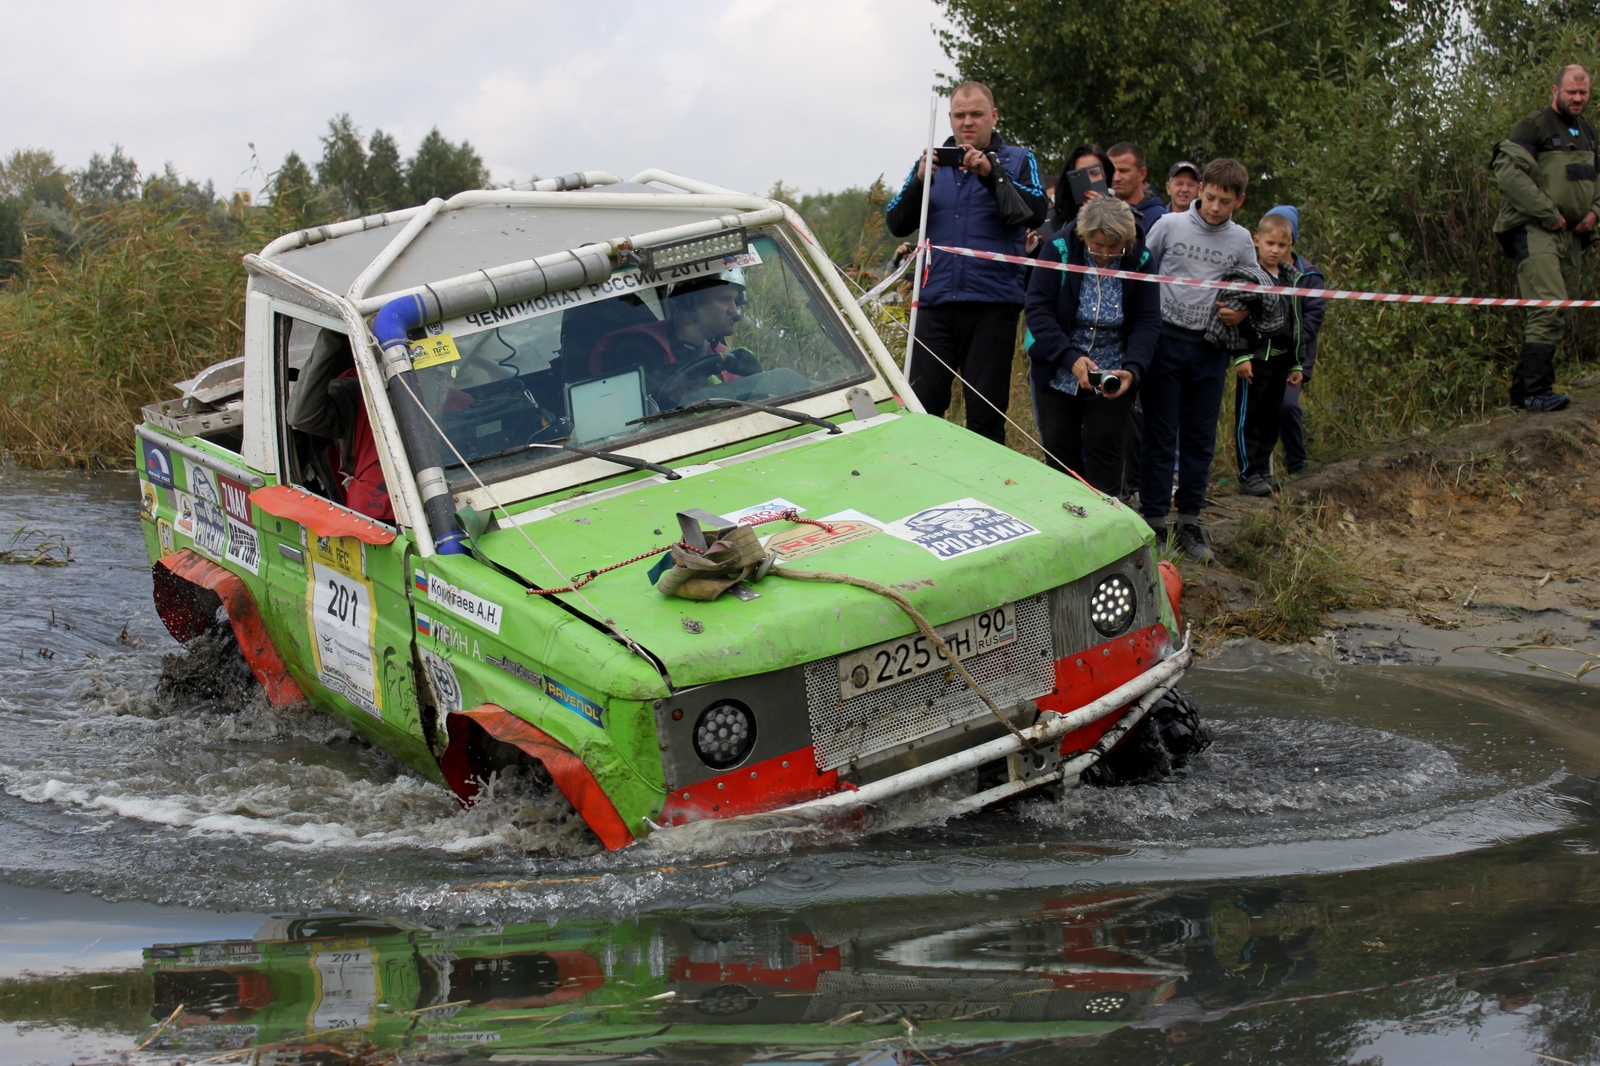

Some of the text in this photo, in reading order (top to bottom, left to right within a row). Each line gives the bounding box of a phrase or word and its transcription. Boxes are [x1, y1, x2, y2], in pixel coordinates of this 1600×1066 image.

[465, 260, 711, 327] ЧЕМПИОНАТ РОССИИ 2017
[221, 481, 249, 521] ZNAK
[196, 520, 226, 557] РОССИИ
[776, 524, 858, 551] RED
[829, 529, 878, 547] expedition
[931, 522, 1032, 555] РОССИИ
[327, 579, 359, 627] 201
[431, 578, 498, 626] Коротаев А.Н.
[978, 608, 1006, 638] 90
[472, 639, 484, 663] А.
[977, 635, 999, 650] RUS
[548, 682, 600, 721] RAVENOL
